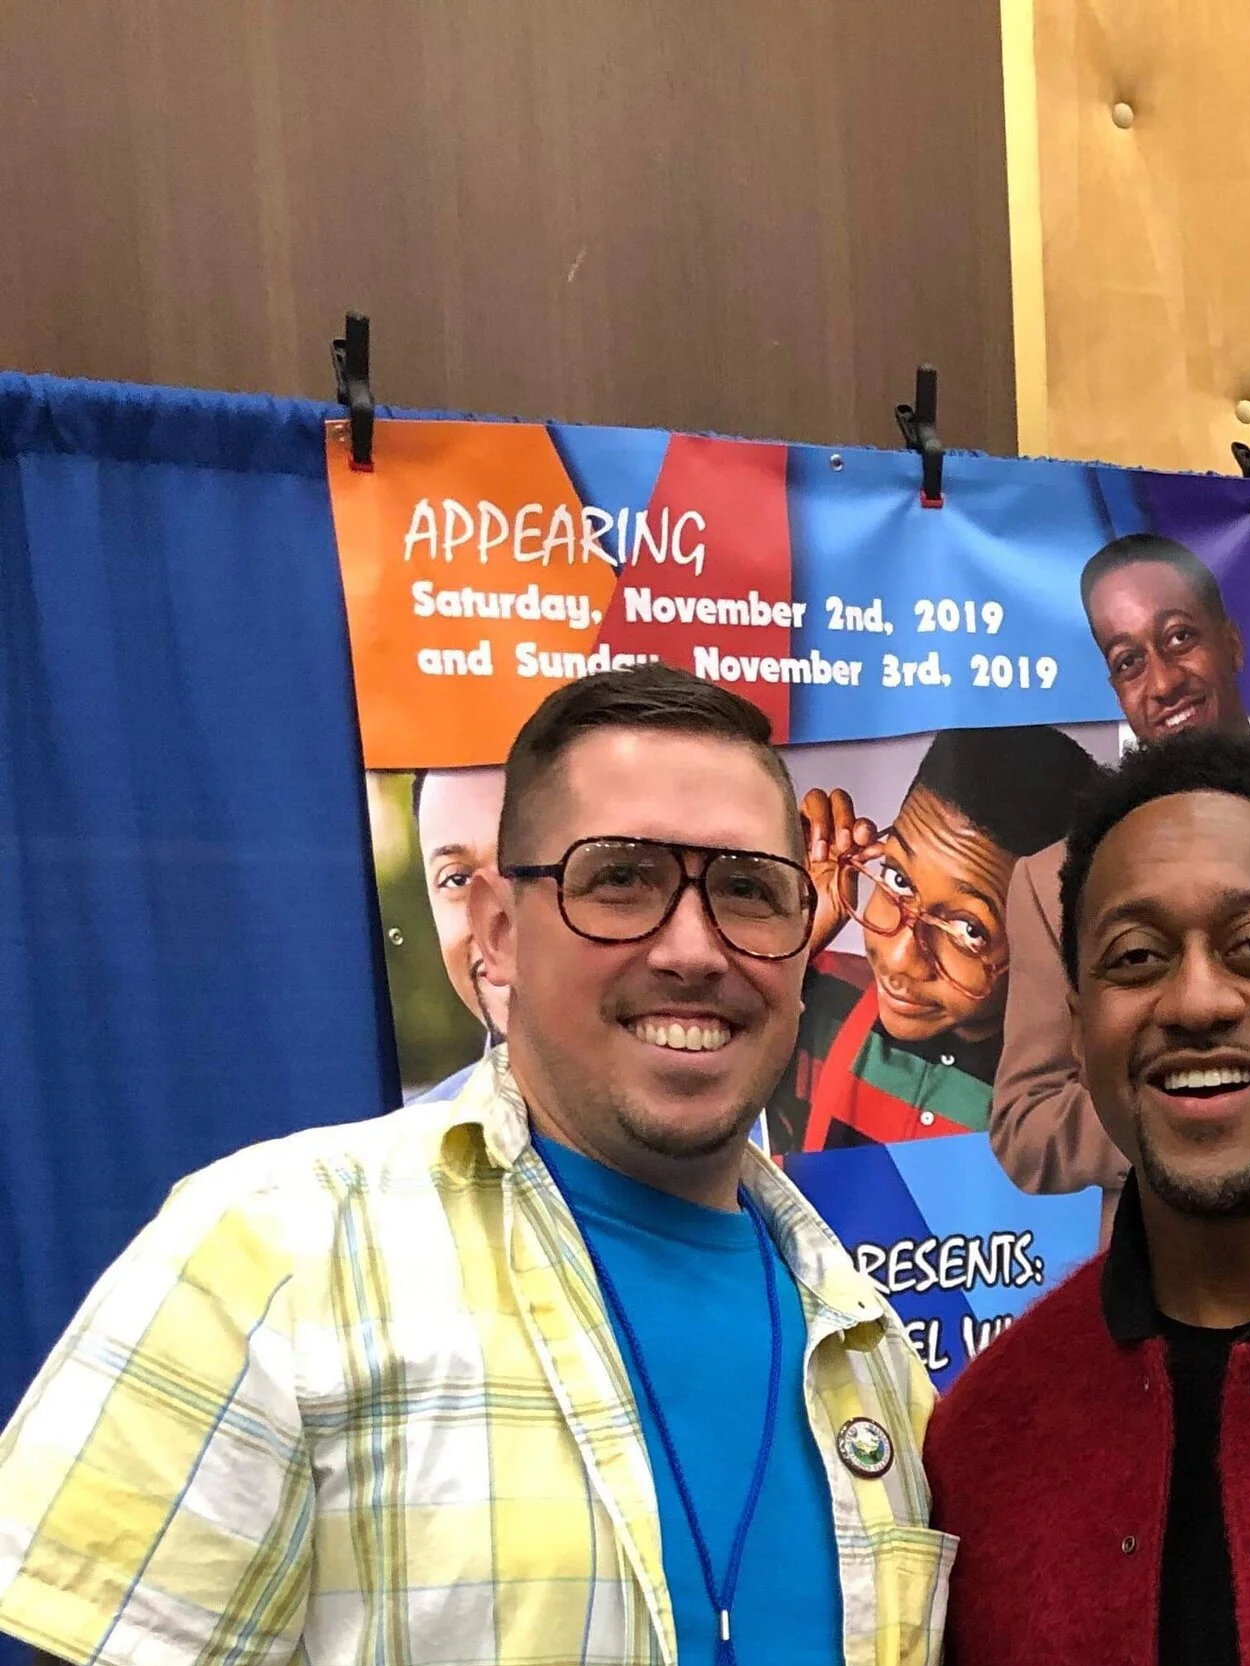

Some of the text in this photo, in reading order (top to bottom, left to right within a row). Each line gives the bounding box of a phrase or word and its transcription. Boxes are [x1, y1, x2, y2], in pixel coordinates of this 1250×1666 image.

[404, 498, 706, 577] APPEARING
[411, 580, 1004, 636] Saturday, November 2nd, 2019
[417, 639, 1059, 690] and Sunda November 3rd, 2019
[856, 1232, 1043, 1295] RESENTS:
